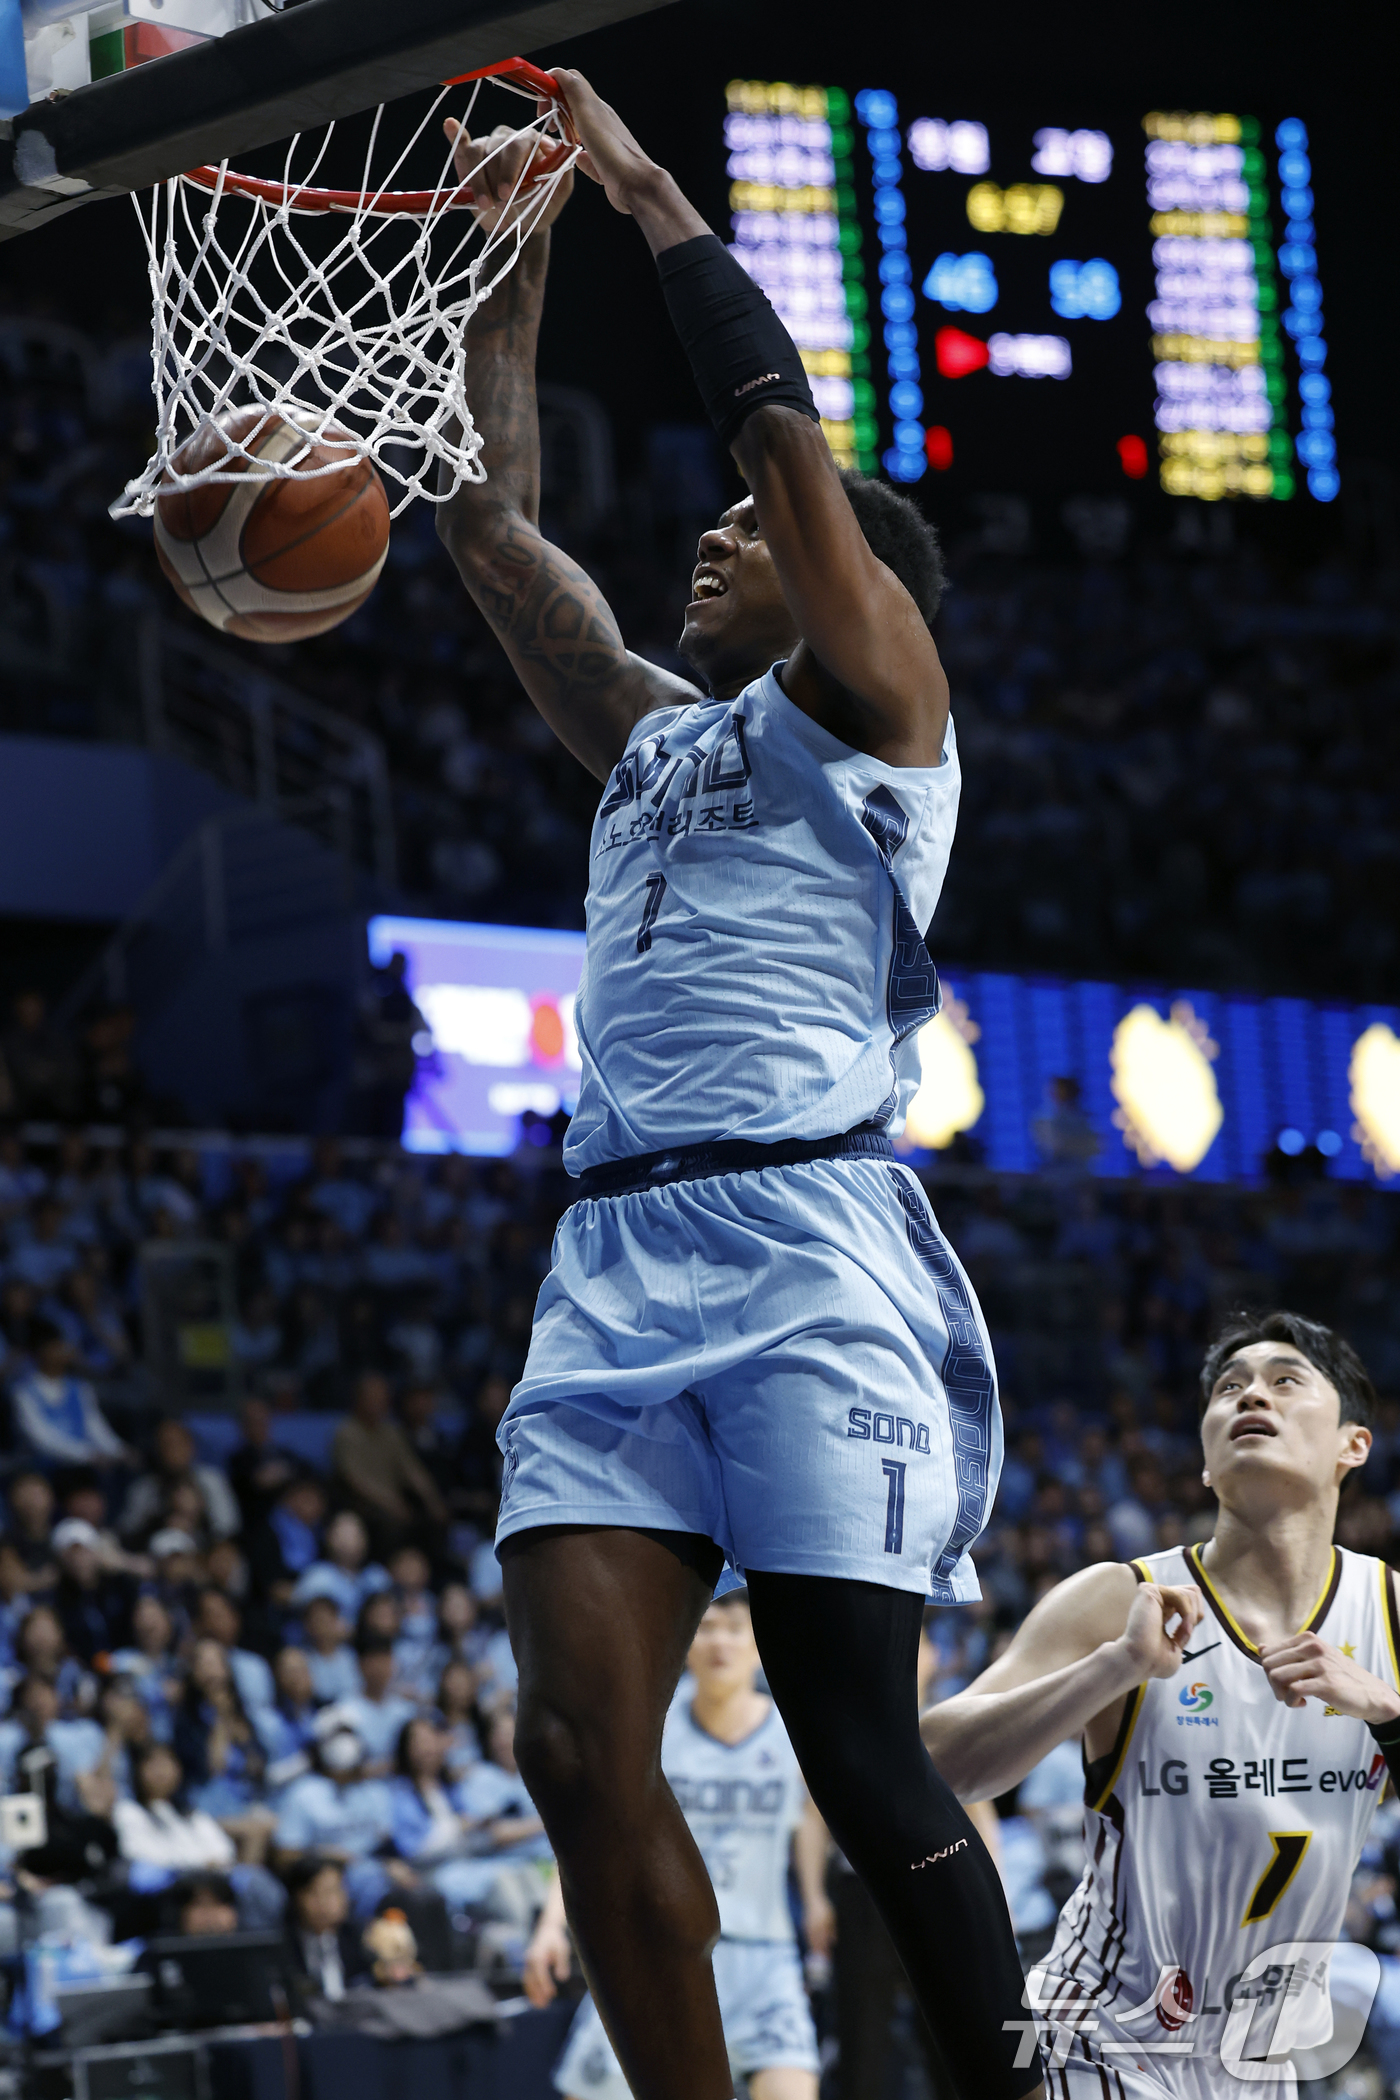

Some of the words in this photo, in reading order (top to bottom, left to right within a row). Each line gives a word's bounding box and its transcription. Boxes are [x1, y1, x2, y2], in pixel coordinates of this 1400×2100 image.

[880, 1457, 907, 1555] 1
[1176, 1715, 1219, 1727] 창원특례시
[1138, 1759, 1190, 1797] LG
[1203, 1757, 1313, 1799] 올레드
[1318, 1769, 1368, 1793] evo
[1240, 1830, 1314, 1929] 7
